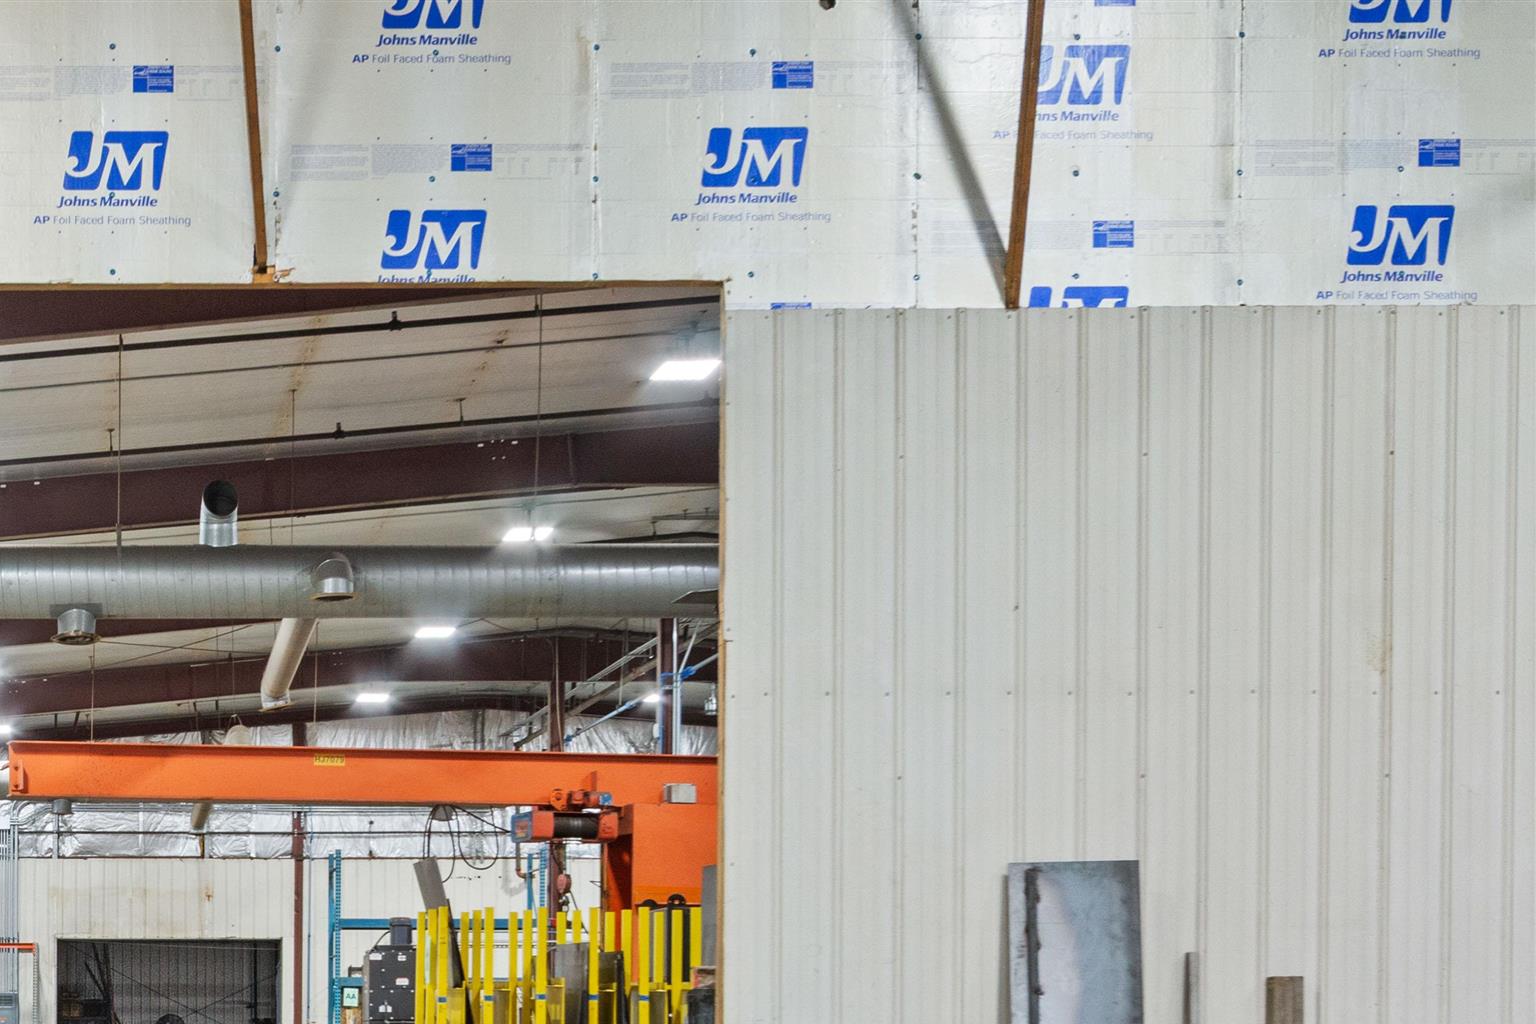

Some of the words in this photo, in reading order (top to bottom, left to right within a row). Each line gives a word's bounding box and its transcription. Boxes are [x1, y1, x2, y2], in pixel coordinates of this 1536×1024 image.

[376, 34, 416, 46] Johns
[419, 34, 477, 45] Manville
[1342, 28, 1384, 41] Johns
[352, 54, 369, 64] AP
[372, 54, 390, 64] Foil
[394, 54, 423, 63] Faced
[427, 54, 456, 63] Foam
[458, 54, 511, 65] Sheathing
[1318, 49, 1335, 58] AP
[1338, 49, 1357, 58] Foil
[1360, 48, 1391, 58] Faced
[1394, 48, 1424, 58] Foam
[1426, 48, 1481, 59] Sheathing
[1060, 110, 1120, 122] Manville
[63, 131, 169, 191] JM
[701, 127, 808, 188] JM
[57, 196, 97, 208] Johns
[100, 196, 158, 207] Manville
[695, 193, 736, 205] Johns
[739, 193, 797, 203] Manville
[33, 216, 50, 225] AP
[53, 216, 71, 225] Foil
[74, 216, 104, 225] Faced
[108, 216, 136, 225] Foam
[138, 216, 192, 227] Sheathing
[671, 213, 688, 222] AP
[691, 213, 709, 222] Foil
[713, 213, 743, 222] Faced
[746, 212, 775, 221] Foam
[778, 212, 831, 223] Sheathing
[381, 209, 487, 269] JM
[1346, 205, 1455, 266] JM
[1340, 271, 1381, 283] Johns
[1384, 271, 1443, 282] Manville
[1316, 291, 1333, 300] AP
[1336, 290, 1354, 300] Foil
[1358, 290, 1388, 300] Faced
[1392, 290, 1421, 300] Foam
[1423, 290, 1478, 301] Sheathing
